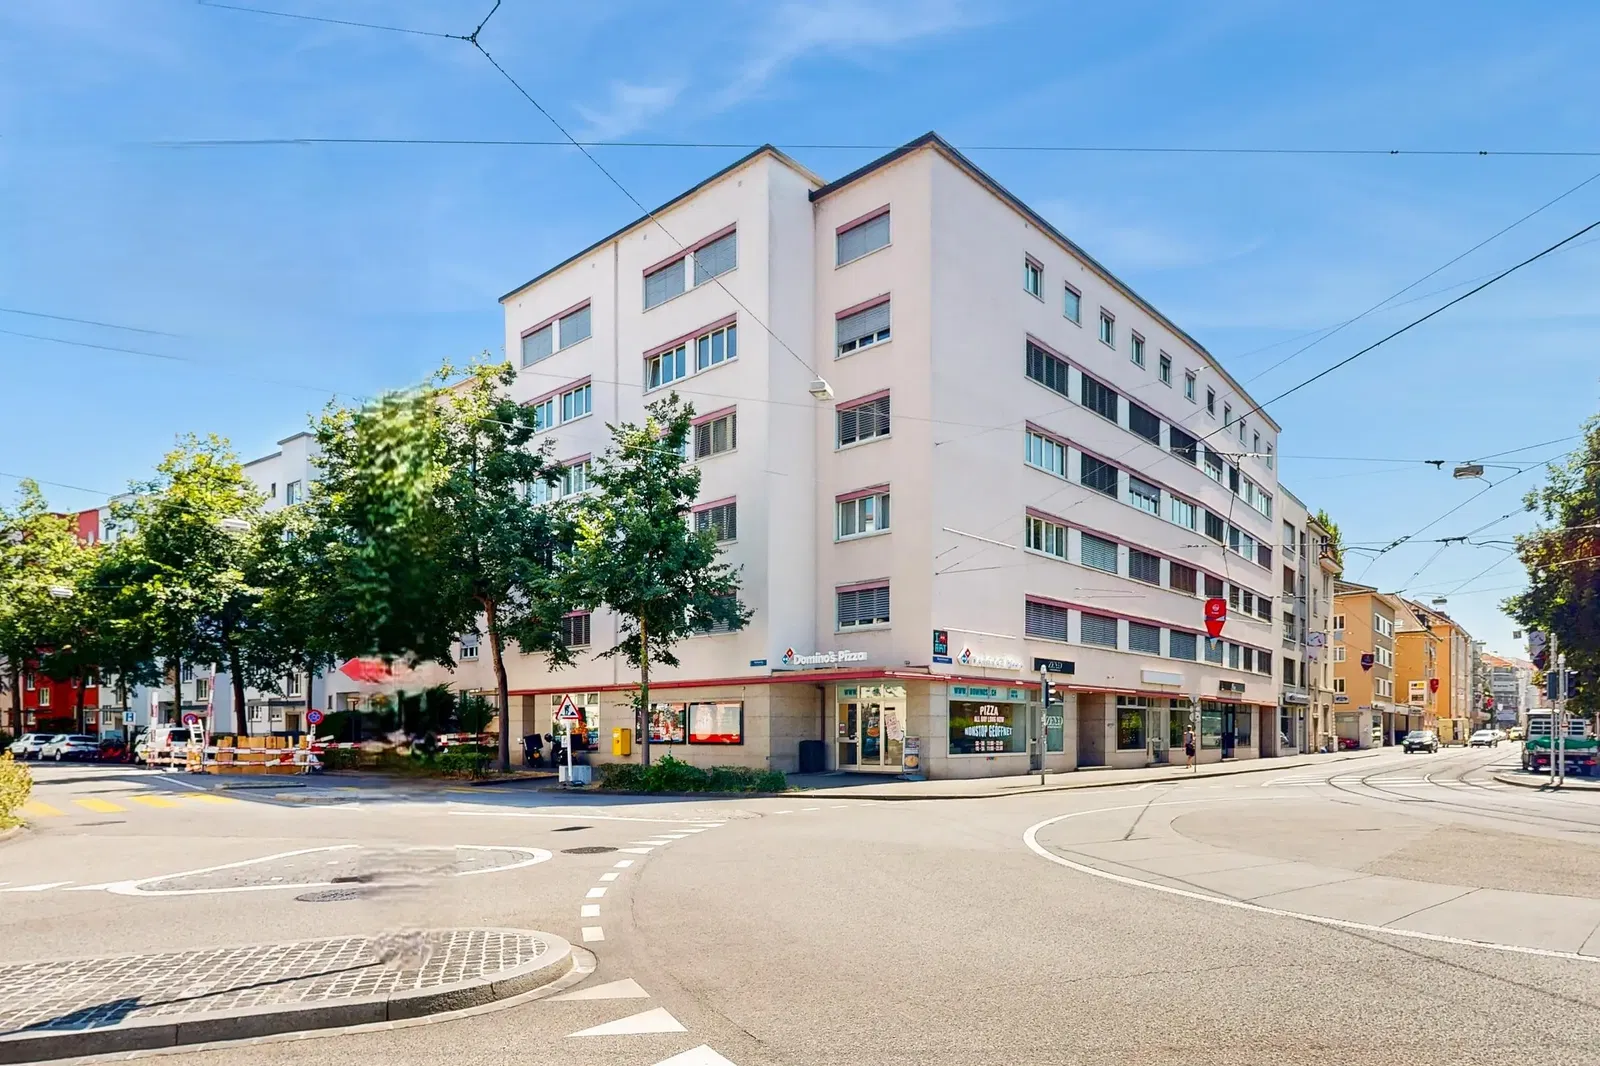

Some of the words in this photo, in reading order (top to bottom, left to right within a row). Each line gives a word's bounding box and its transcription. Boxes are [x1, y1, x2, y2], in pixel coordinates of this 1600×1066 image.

[793, 651, 837, 665] Domino's
[838, 650, 867, 662] Pizza
[980, 705, 998, 716] PIZZA
[965, 725, 988, 737] NONSTOP
